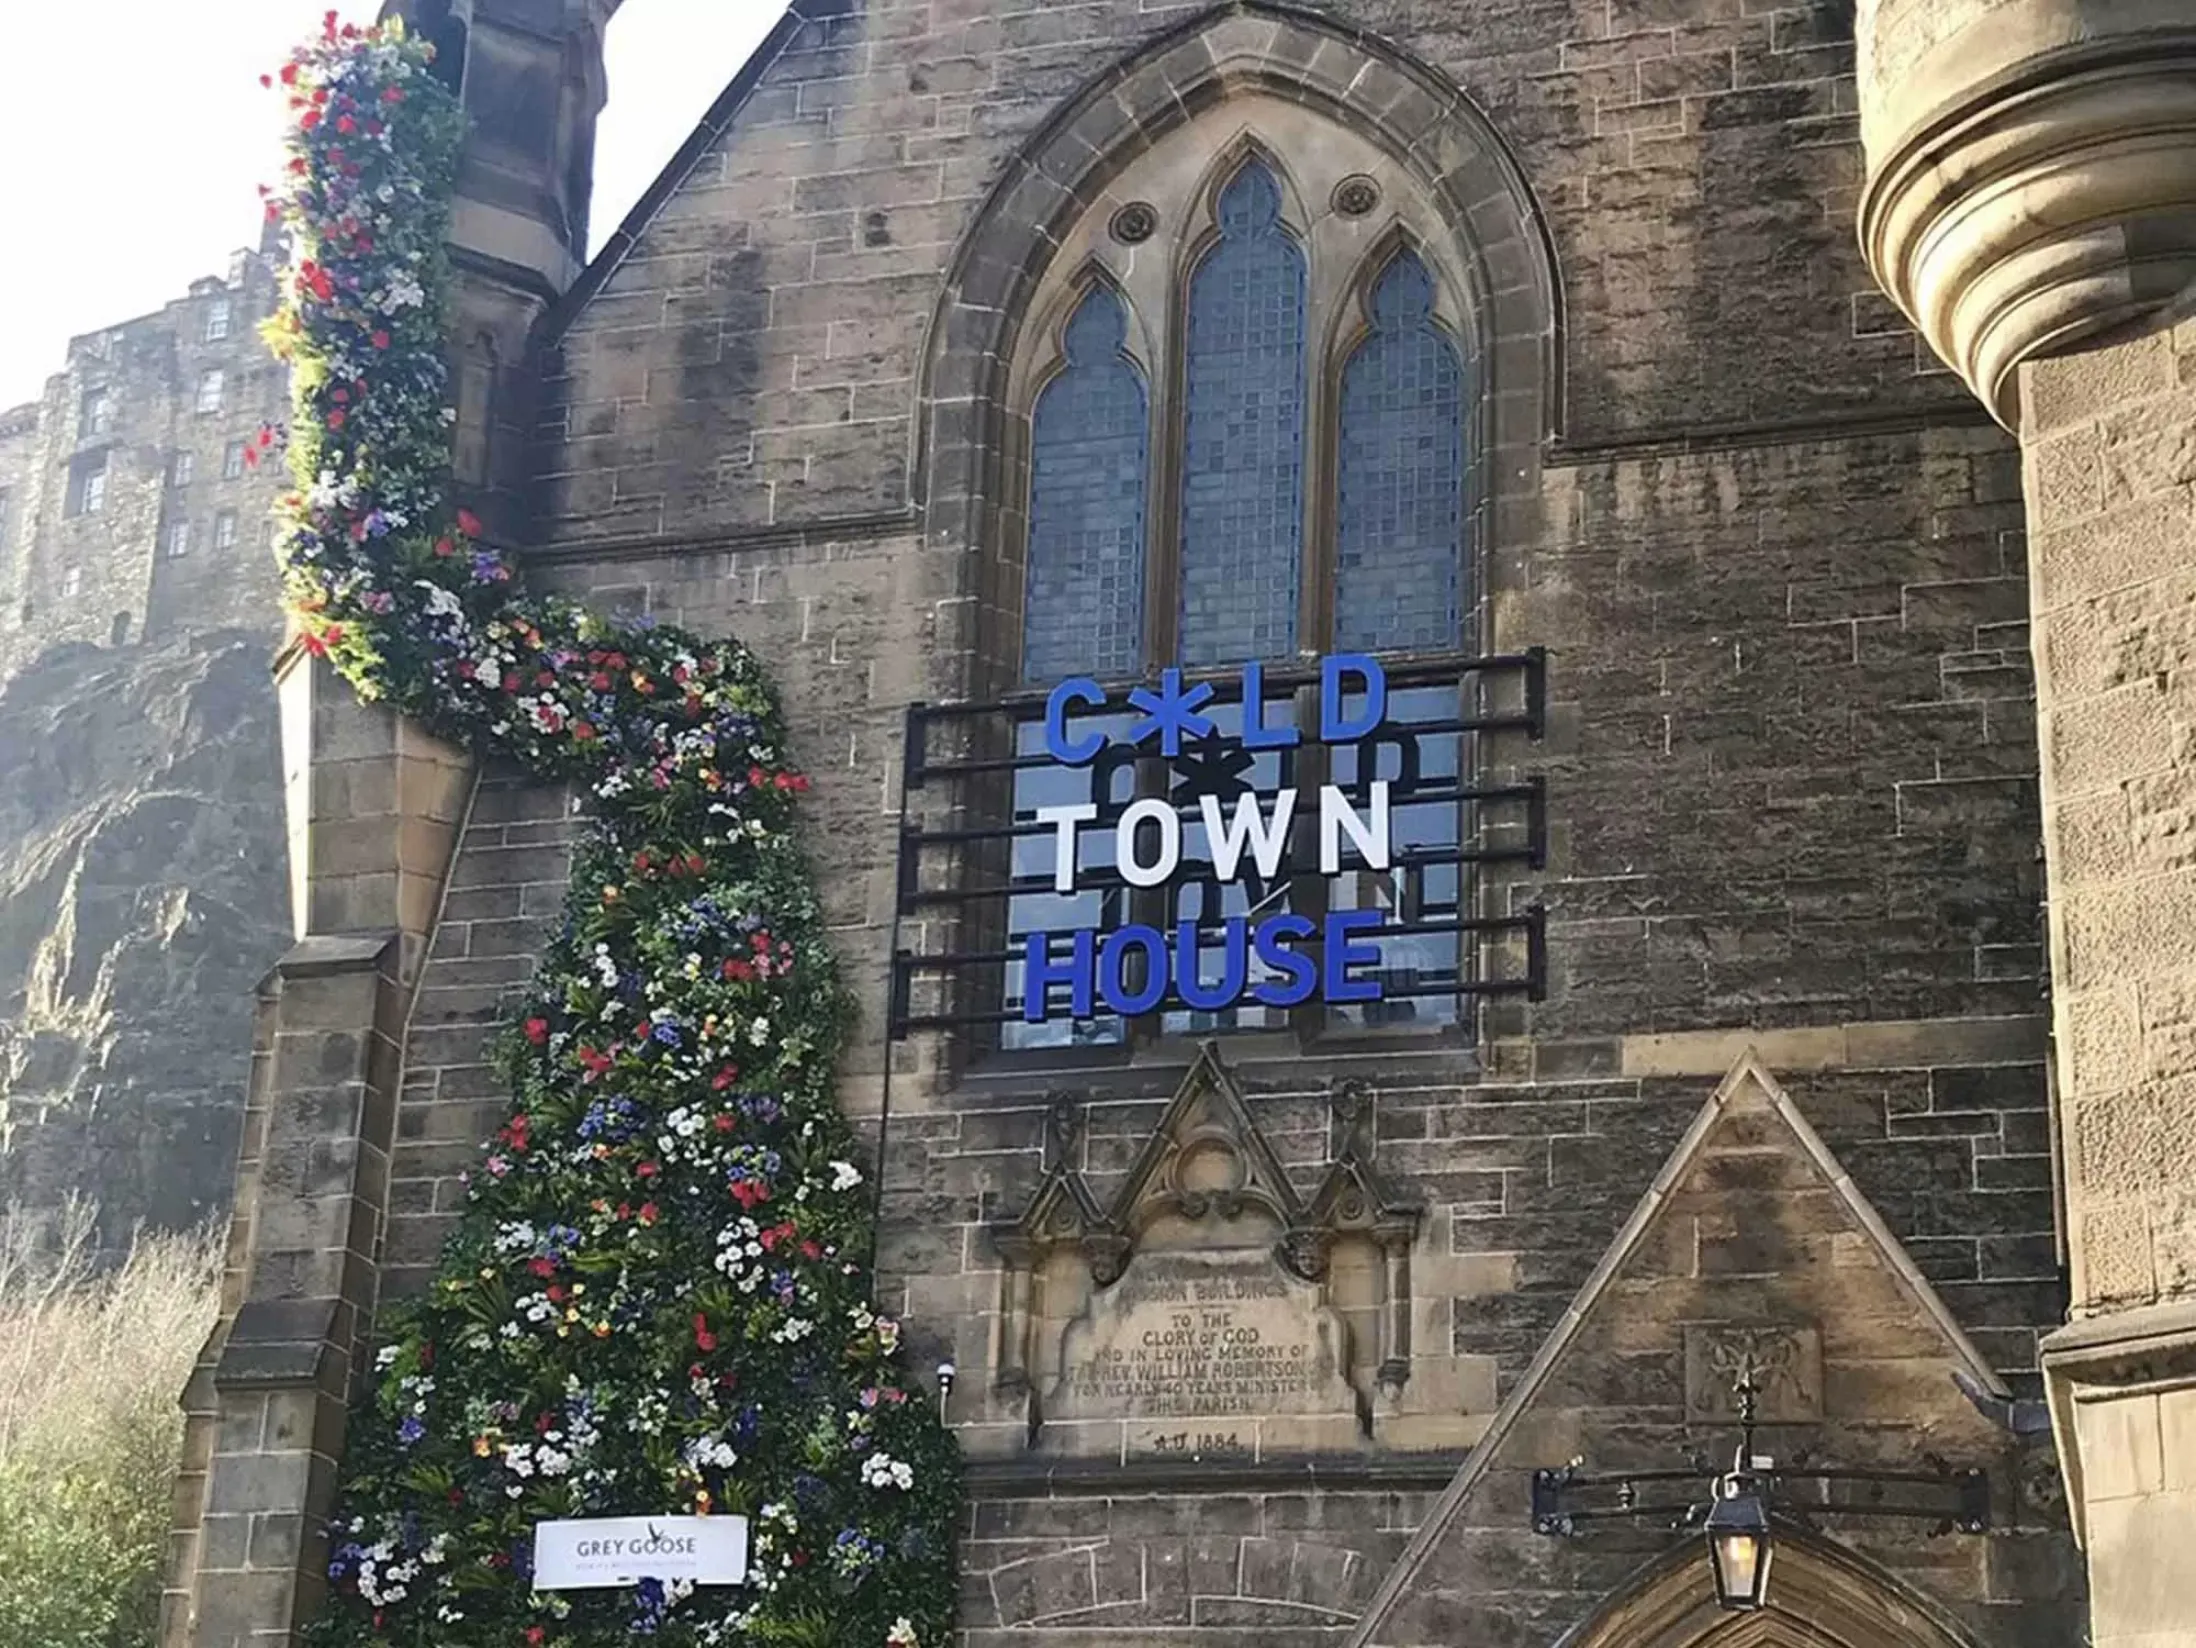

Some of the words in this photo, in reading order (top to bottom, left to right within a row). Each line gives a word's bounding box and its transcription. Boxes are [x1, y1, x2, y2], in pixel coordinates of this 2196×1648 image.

[1036, 781, 1391, 892] TOWN
[1023, 910, 1384, 1021] HOUSE
[1171, 1314, 1191, 1328] TO
[1202, 1313, 1232, 1327] THE
[1131, 1350, 1146, 1362] IN
[1155, 1348, 1212, 1362] LOVING
[1218, 1346, 1283, 1360] MEMORY
[1137, 1361, 1207, 1381] WILLIAM
[1213, 1359, 1306, 1379] ROBERTSON
[577, 1539, 624, 1557] GREY
[629, 1537, 697, 1555] GOOSE
